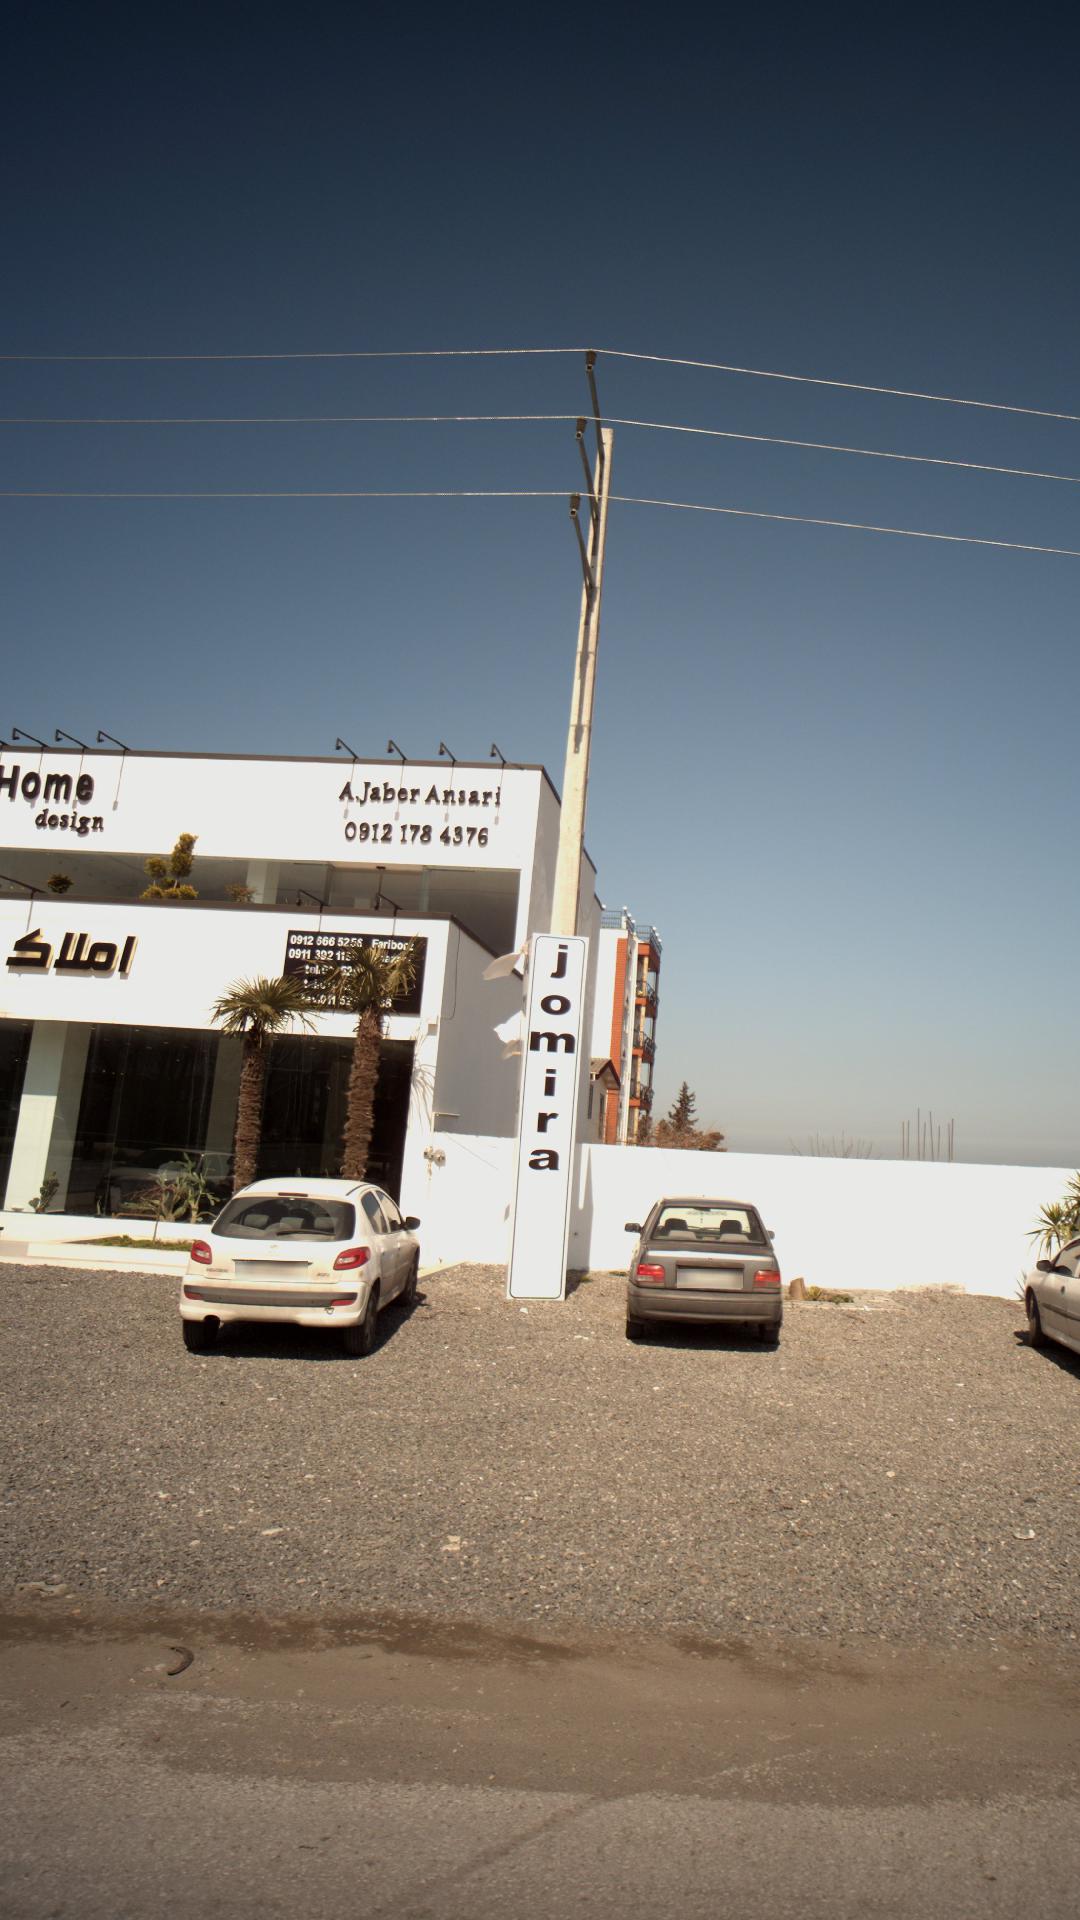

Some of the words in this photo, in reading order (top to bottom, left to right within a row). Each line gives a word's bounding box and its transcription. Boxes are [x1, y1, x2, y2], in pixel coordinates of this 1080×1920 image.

[0, 765, 94, 803] Home
[425, 784, 501, 806] Ansari
[35, 808, 104, 836] design
[345, 821, 392, 842] 0912
[400, 824, 432, 844] 178
[440, 826, 488, 847] 4376
[290, 935, 314, 946] 0912
[288, 948, 311, 960] 0911
[528, 944, 576, 1171] jomira
